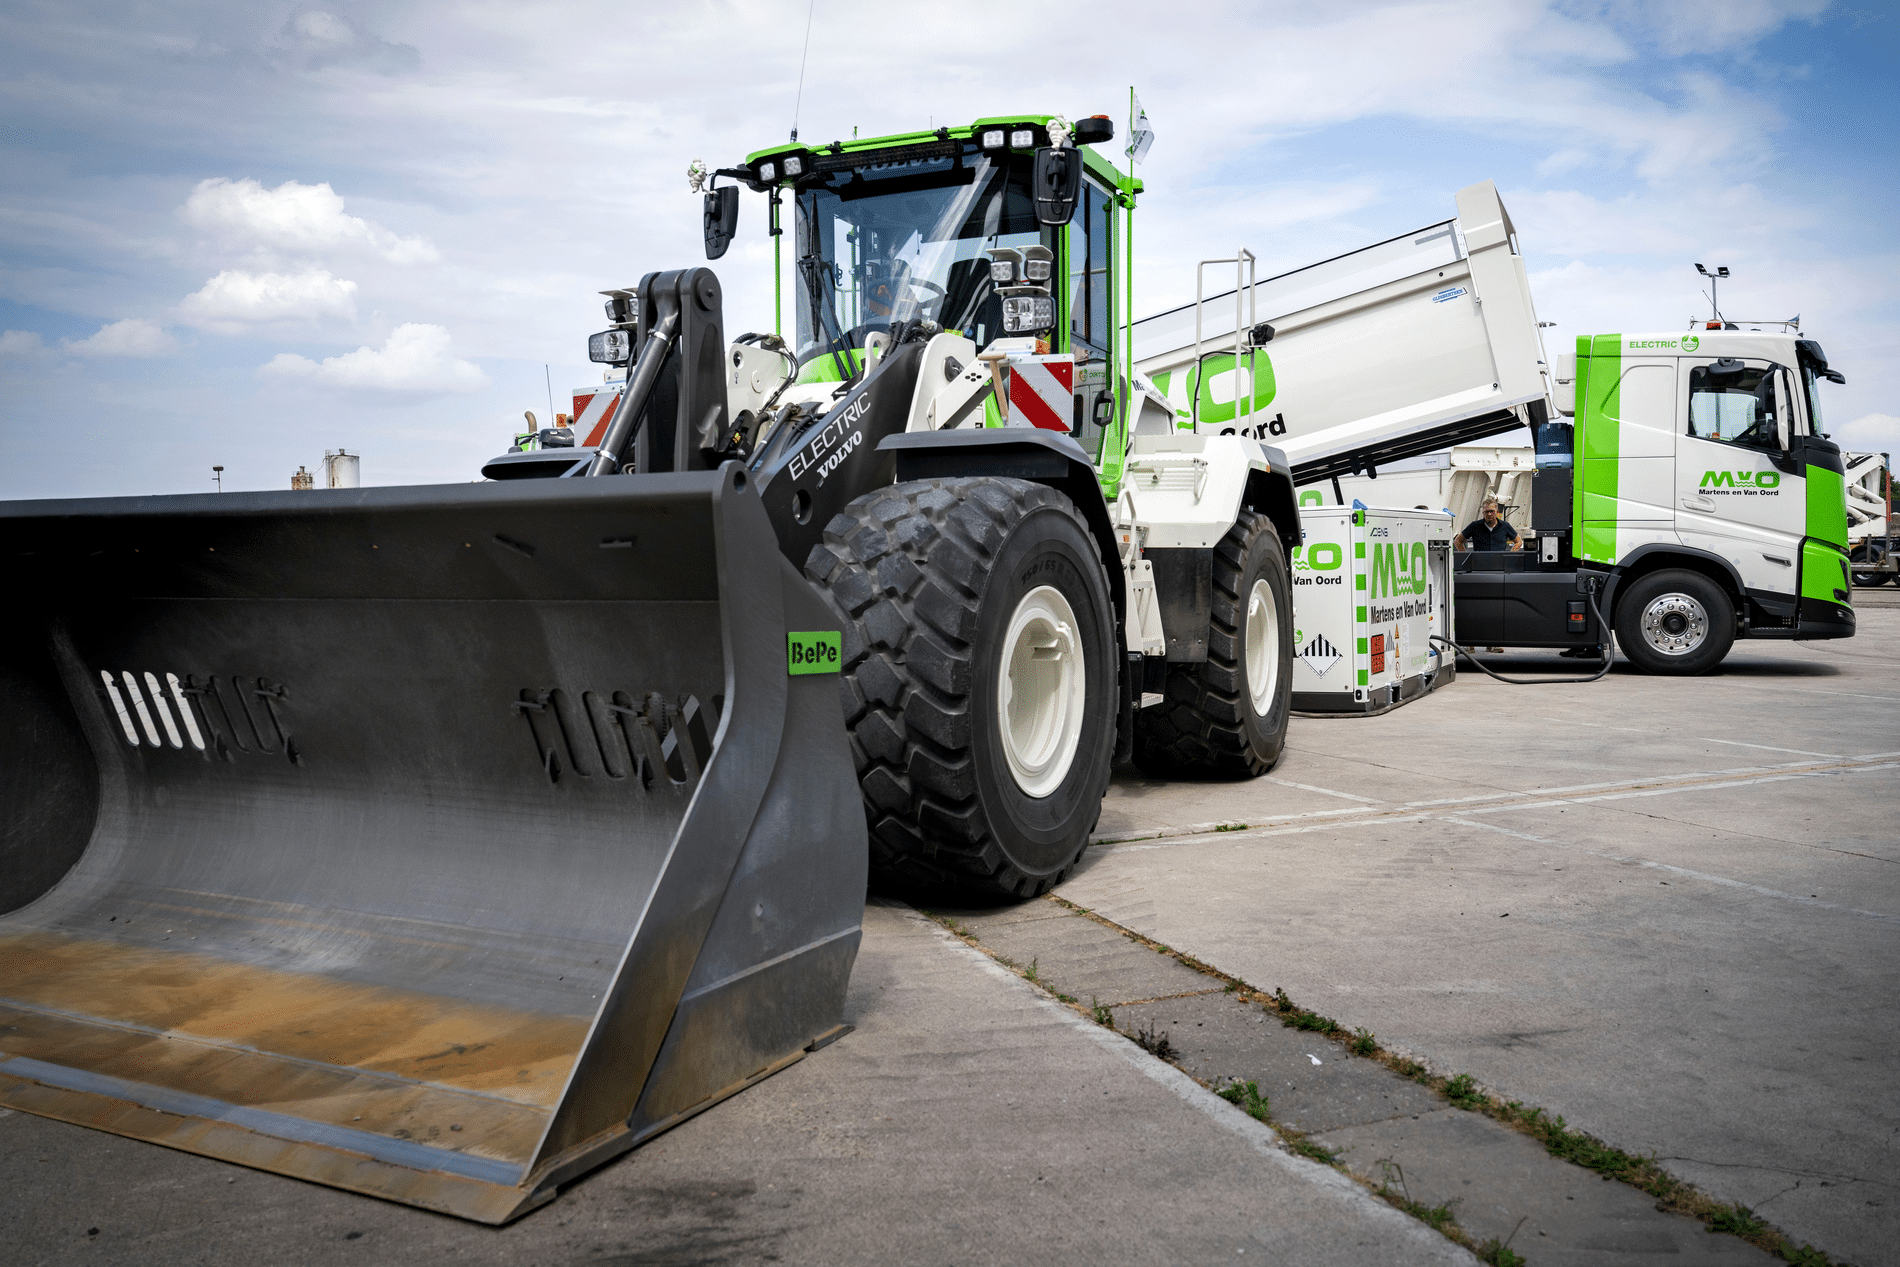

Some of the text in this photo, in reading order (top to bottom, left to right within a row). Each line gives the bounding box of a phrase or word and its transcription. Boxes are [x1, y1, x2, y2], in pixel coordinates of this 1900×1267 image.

[1629, 341, 1678, 349] ELECTRIC
[787, 391, 871, 481] ELECTRIC
[816, 430, 863, 479] VOLVO
[1294, 575, 1342, 586] Van Oord
[1370, 598, 1427, 625] Martens en Van Oord
[791, 641, 837, 665] BePe
